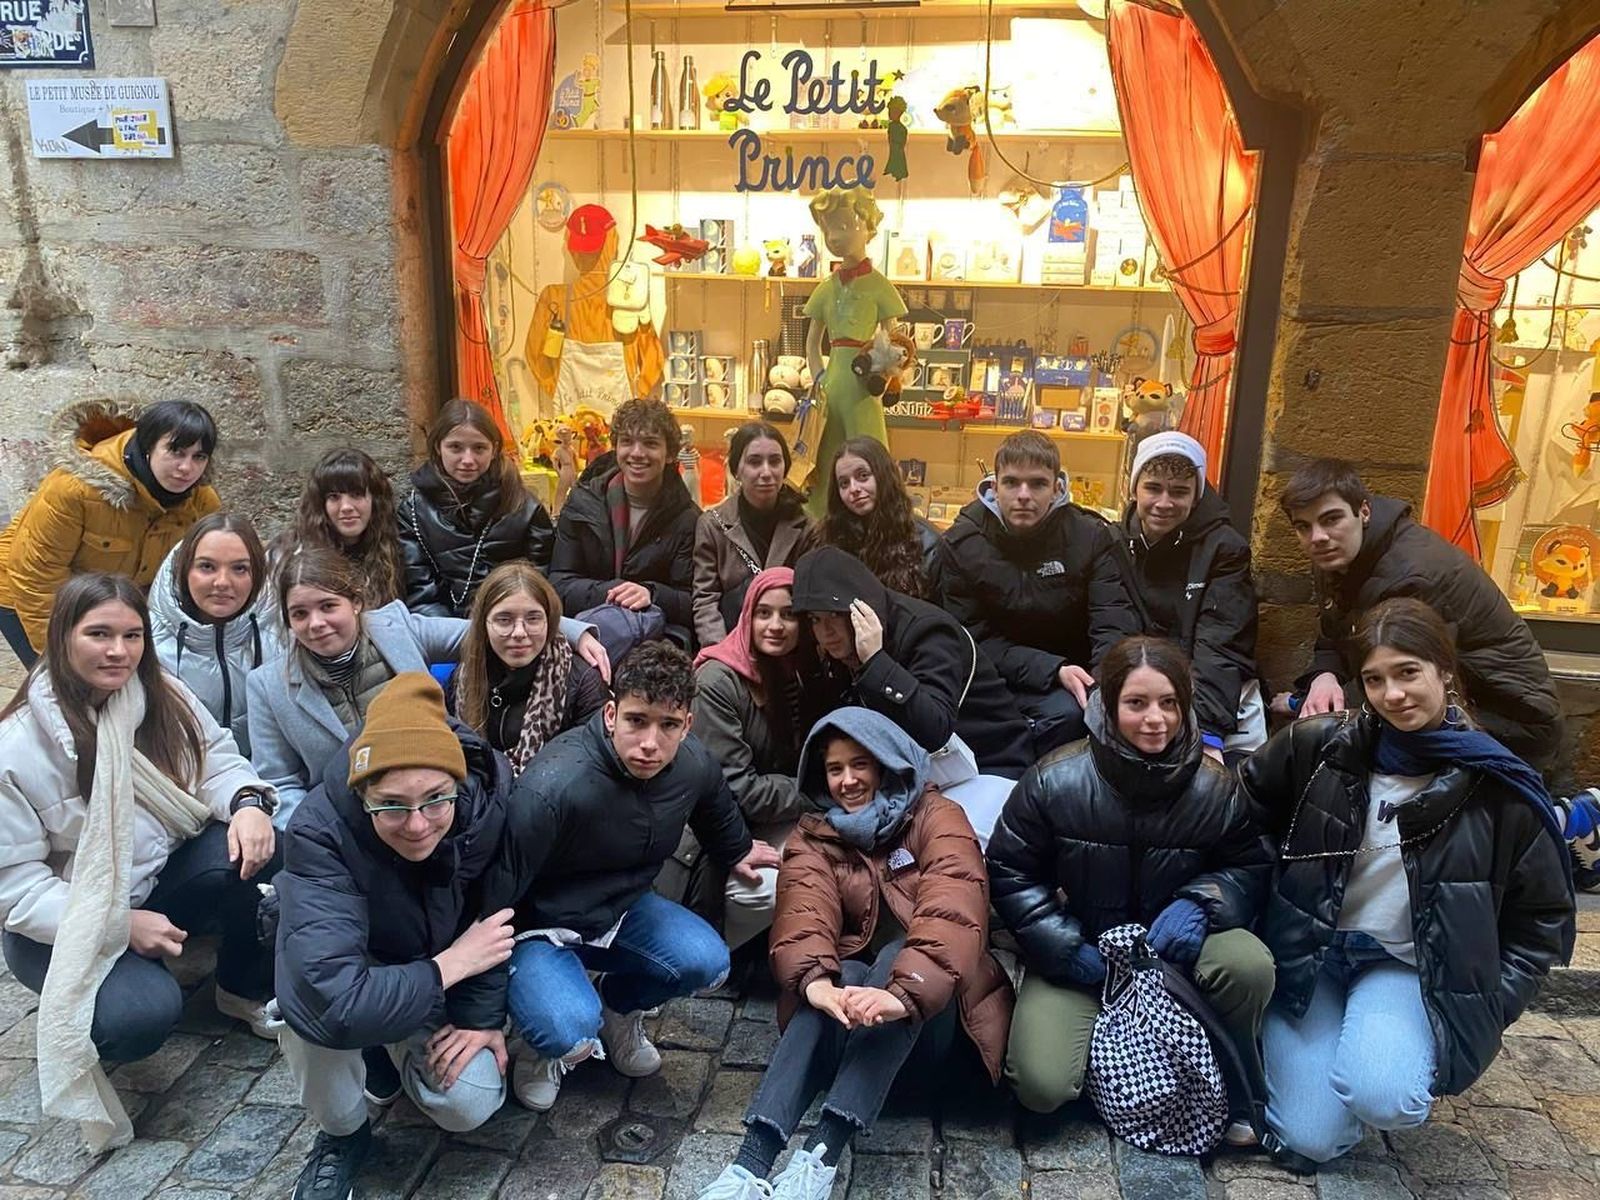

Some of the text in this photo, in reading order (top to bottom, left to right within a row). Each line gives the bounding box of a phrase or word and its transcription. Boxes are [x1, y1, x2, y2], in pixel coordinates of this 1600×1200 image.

[0, 1, 42, 21] RUE
[29, 86, 41, 101] LE
[42, 86, 69, 101] PETIT
[104, 86, 117, 100] DE
[118, 84, 160, 100] GUIGNOL
[723, 49, 887, 115] Le Petit
[728, 128, 877, 192] Prince
